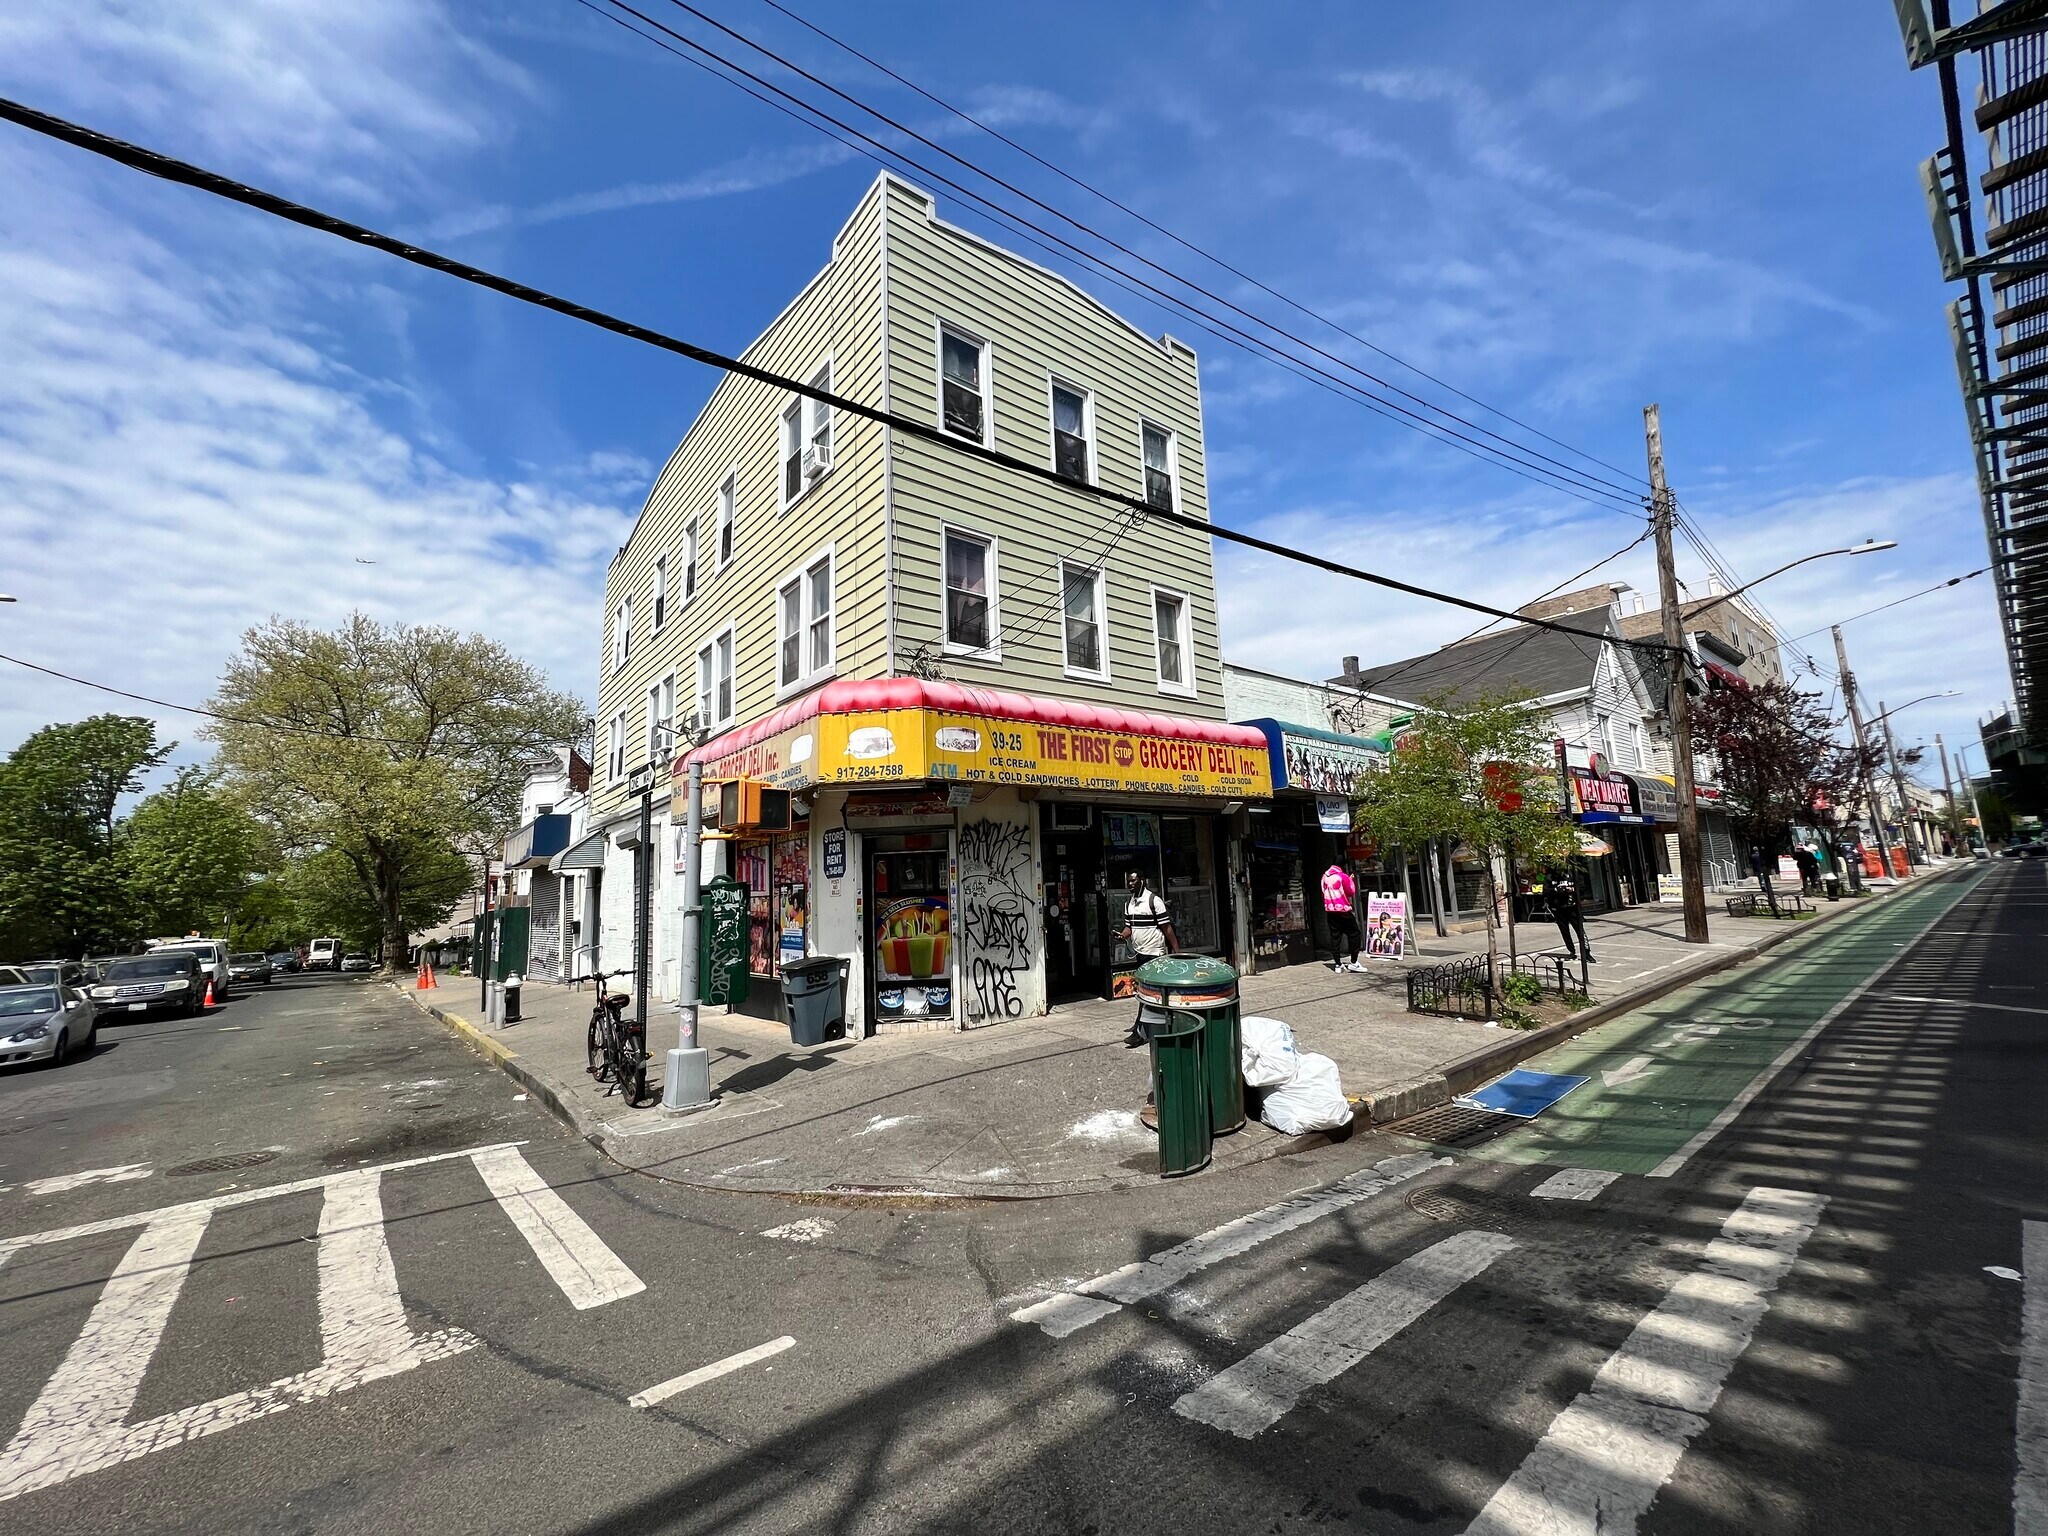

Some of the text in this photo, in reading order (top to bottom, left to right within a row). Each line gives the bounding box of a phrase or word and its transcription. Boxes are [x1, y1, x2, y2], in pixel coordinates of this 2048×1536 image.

[991, 731, 1022, 751] 39-25
[1037, 730, 1067, 760] THE
[1071, 733, 1111, 764] FIRST
[1114, 746, 1132, 759] STOP
[1139, 740, 1205, 771] GROCERY
[1207, 746, 1237, 775] DELI
[1240, 755, 1260, 776] Inc.
[719, 746, 779, 779] GROCERY DELI Inc.
[989, 757, 1004, 766] ICE
[1006, 758, 1036, 769] CREAM
[781, 764, 802, 780] CANDIES
[837, 764, 904, 778] 917-284-7588
[931, 763, 958, 777] ATM
[966, 769, 1242, 794] HOT & COLD SANDWICHES LOTTERY PHONE CARDS CANDIES COLD CUTS
[1182, 774, 1199, 783] COLD
[1220, 776, 1236, 784] COLD
[1237, 777, 1252, 785] SODA
[1580, 778, 1601, 803] MEAT
[1600, 781, 1630, 804] MARKET
[824, 830, 844, 843] STORE
[829, 842, 841, 854] FOR
[826, 854, 842, 865] RENT
[880, 911, 889, 920] WE
[889, 903, 901, 913] SELL
[806, 970, 828, 984] 658
[878, 989, 902, 998] AriZona
